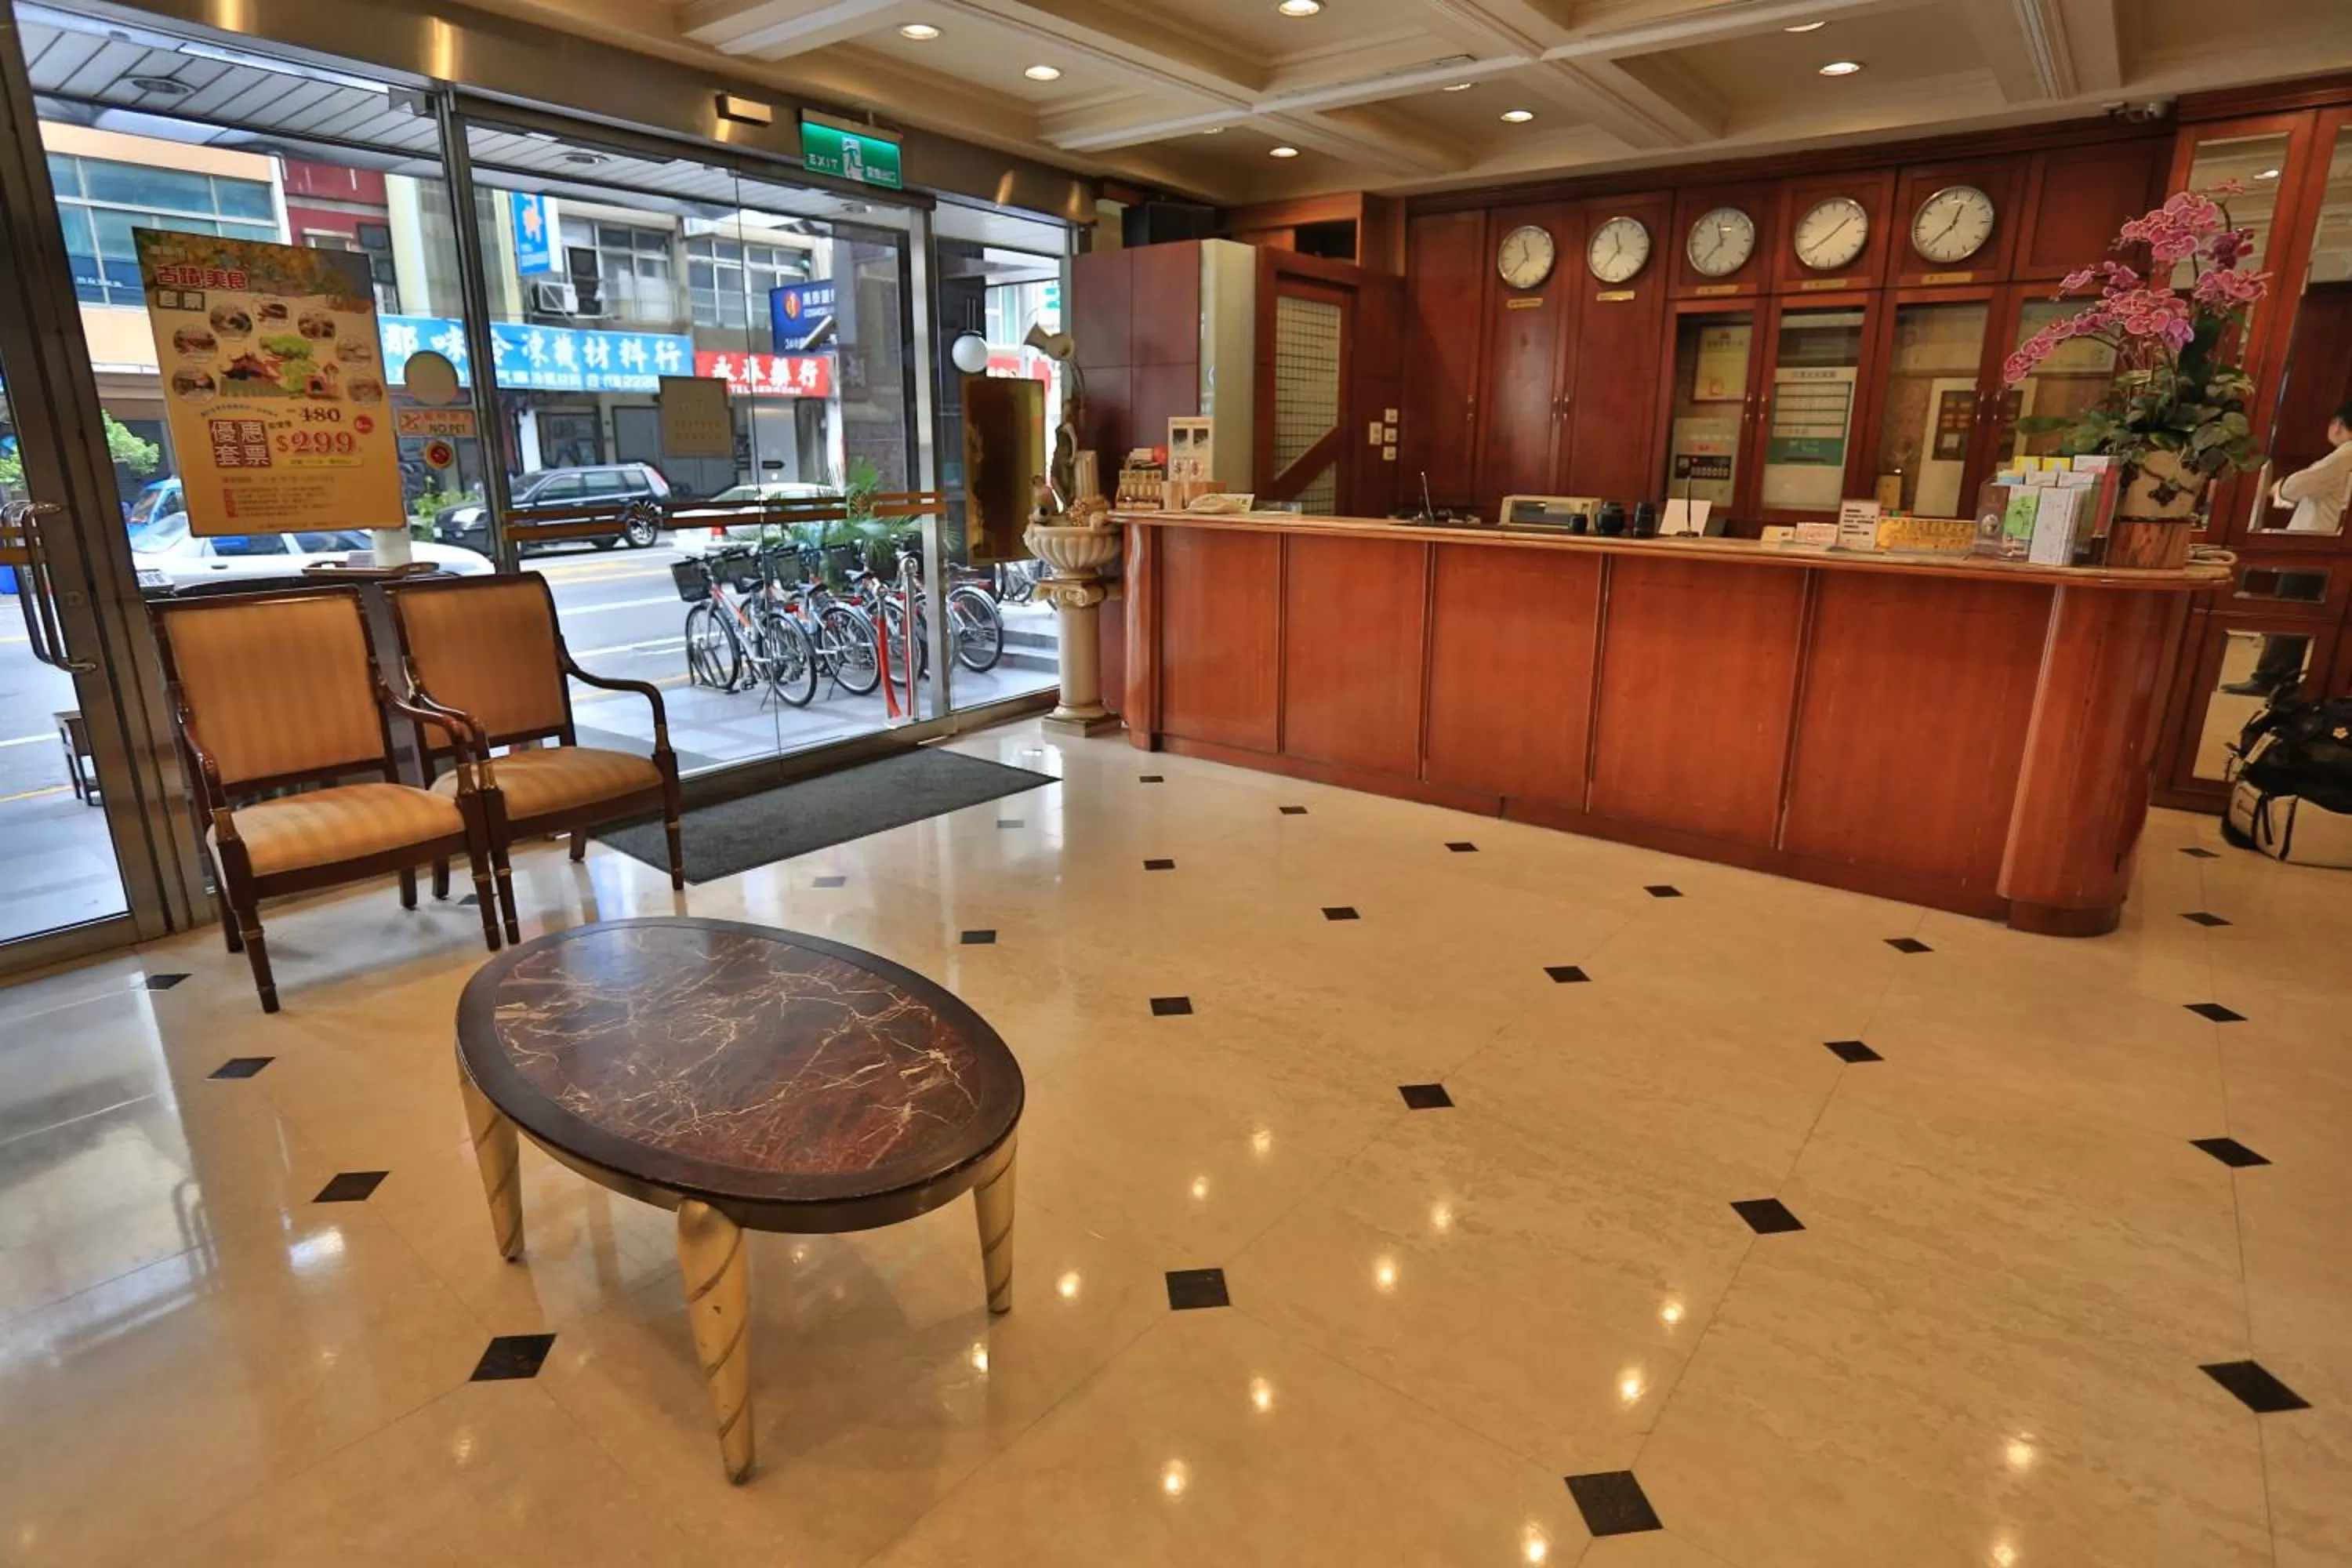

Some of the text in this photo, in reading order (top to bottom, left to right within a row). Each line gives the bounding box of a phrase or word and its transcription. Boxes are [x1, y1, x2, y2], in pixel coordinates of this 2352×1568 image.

[808, 154, 838, 169] EXIT
[429, 423, 466, 433] NO PET
